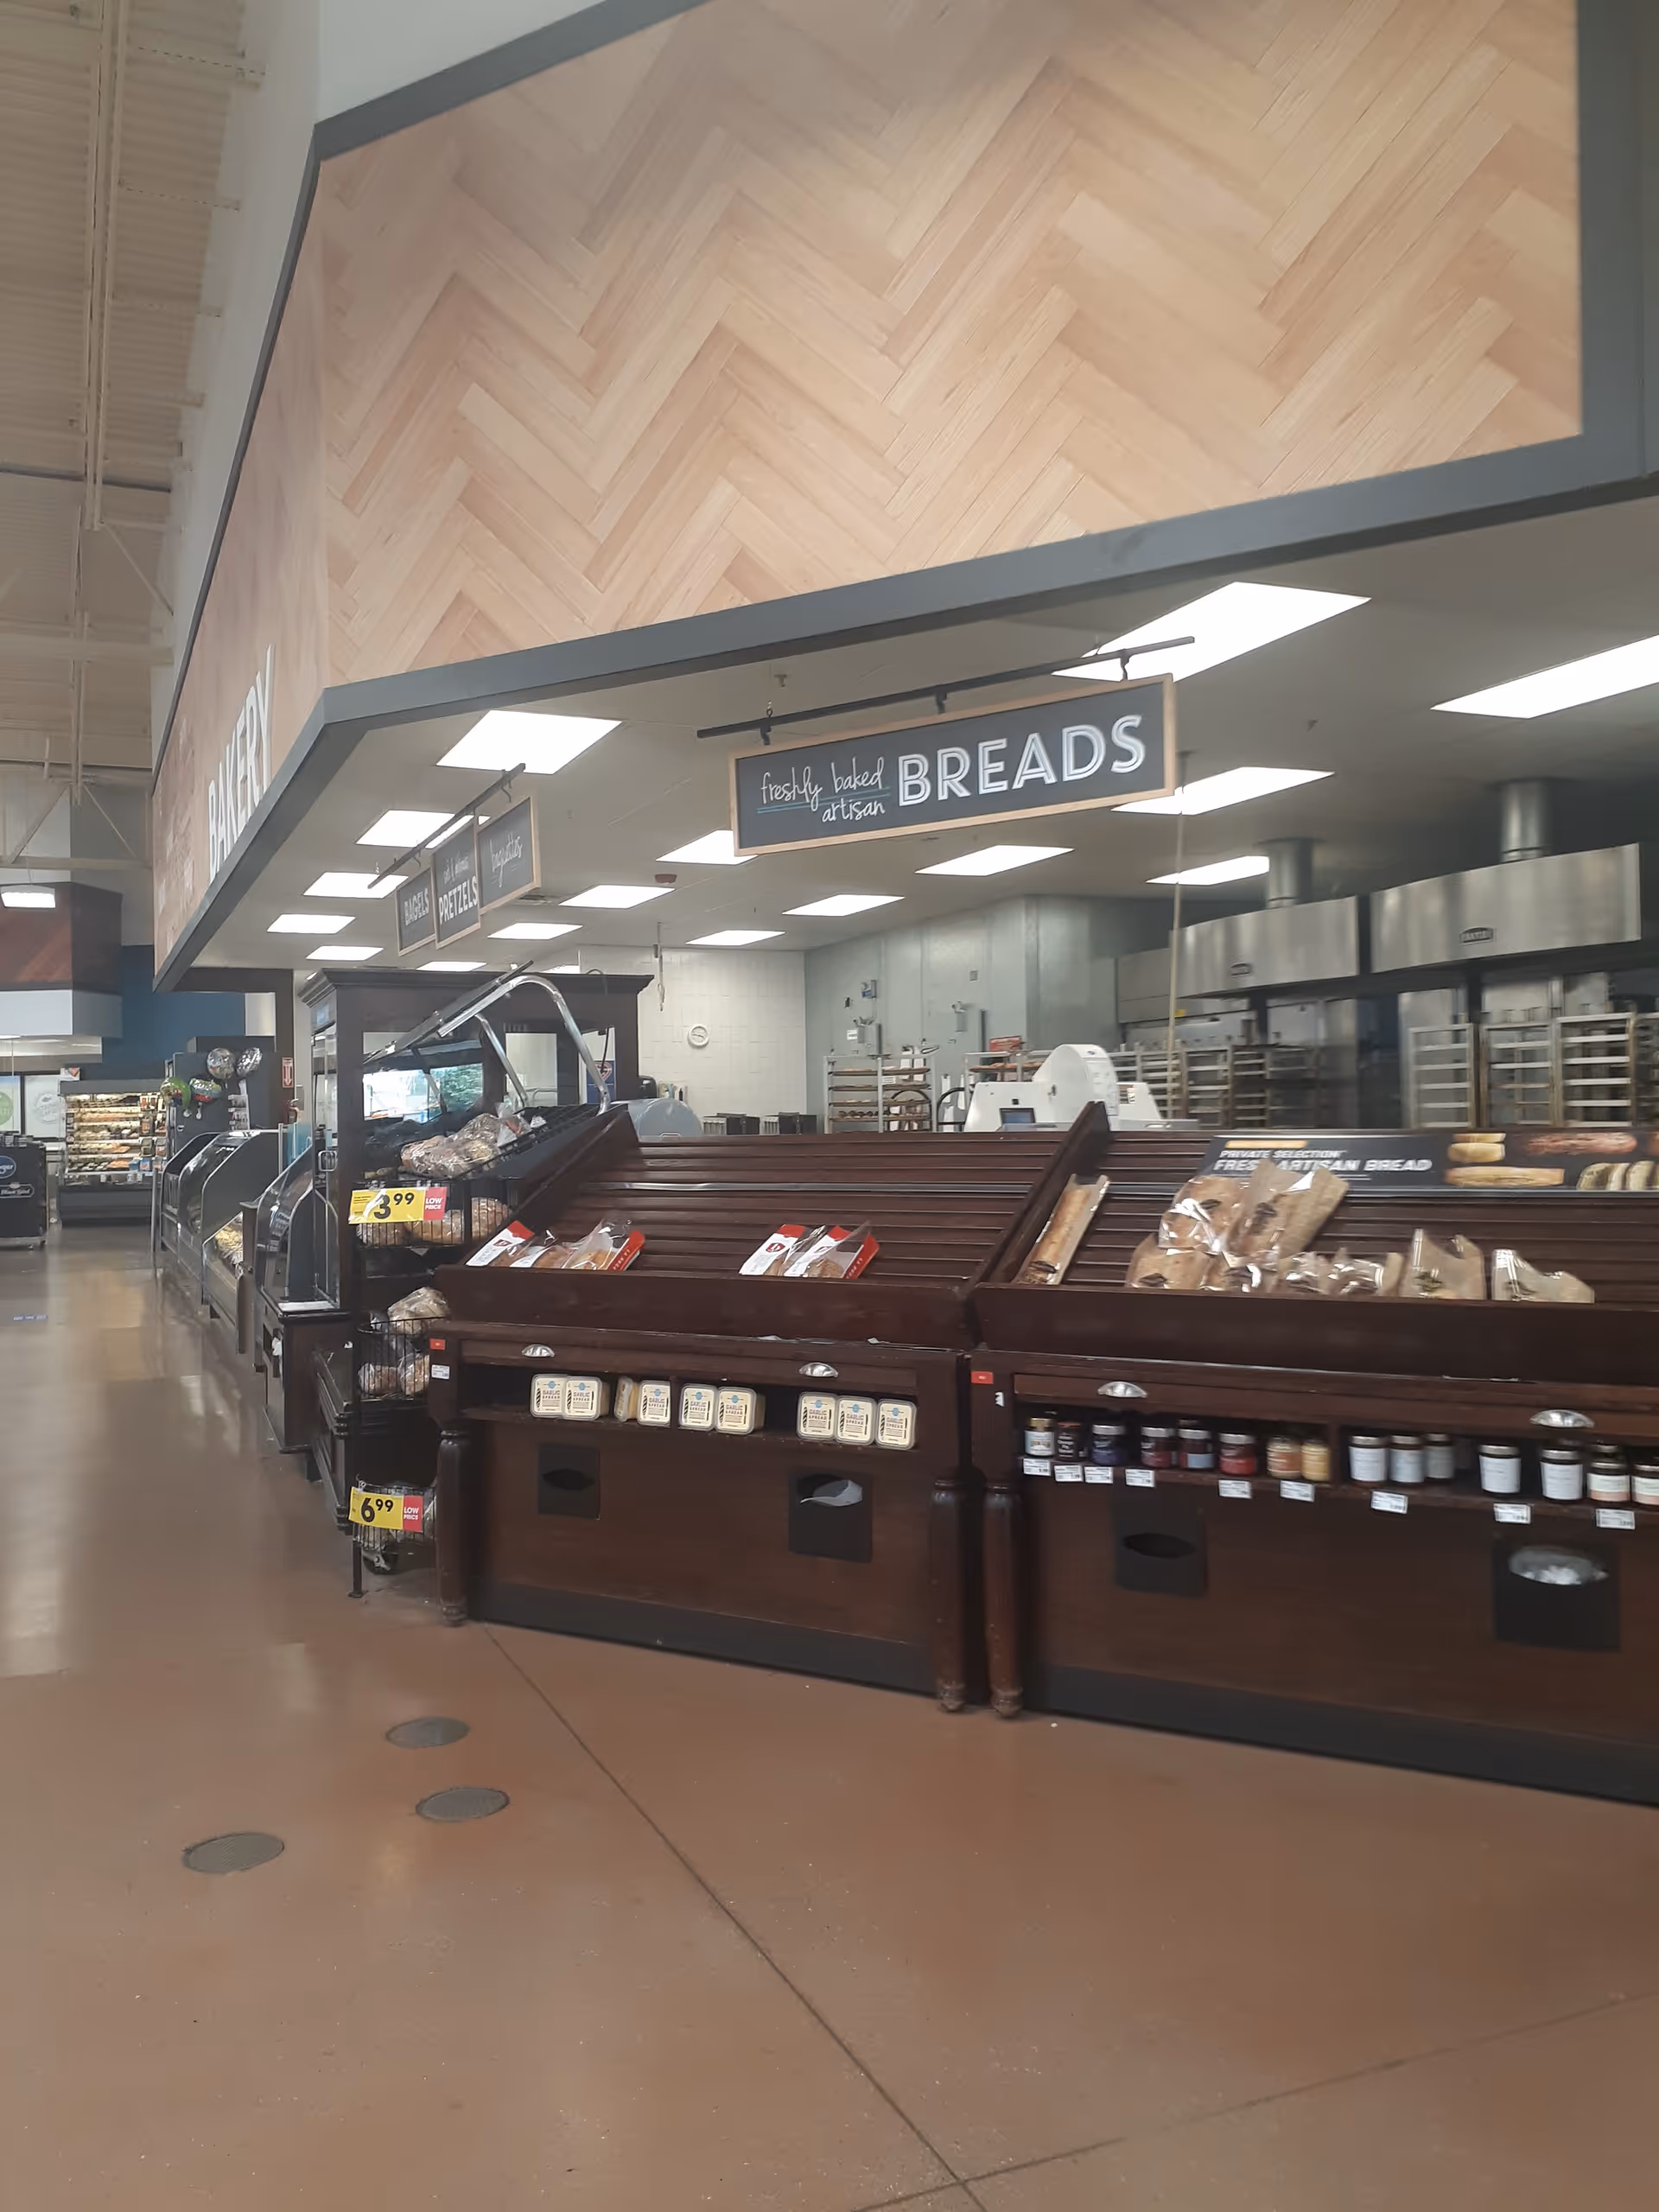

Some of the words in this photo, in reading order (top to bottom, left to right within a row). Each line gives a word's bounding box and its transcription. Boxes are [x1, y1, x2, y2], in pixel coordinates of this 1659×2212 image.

[207, 645, 275, 884] BAKERY
[898, 715, 1146, 806] BREADS
[760, 766, 823, 811] freshly
[830, 756, 884, 793] baked
[822, 798, 886, 823] artisan
[404, 887, 429, 926] BAGELS
[438, 875, 479, 925] PRETZELS
[1212, 1160, 1261, 1171] FRES
[1363, 1159, 1433, 1172] BREAD
[1218, 1150, 1271, 1159] PRIVATE
